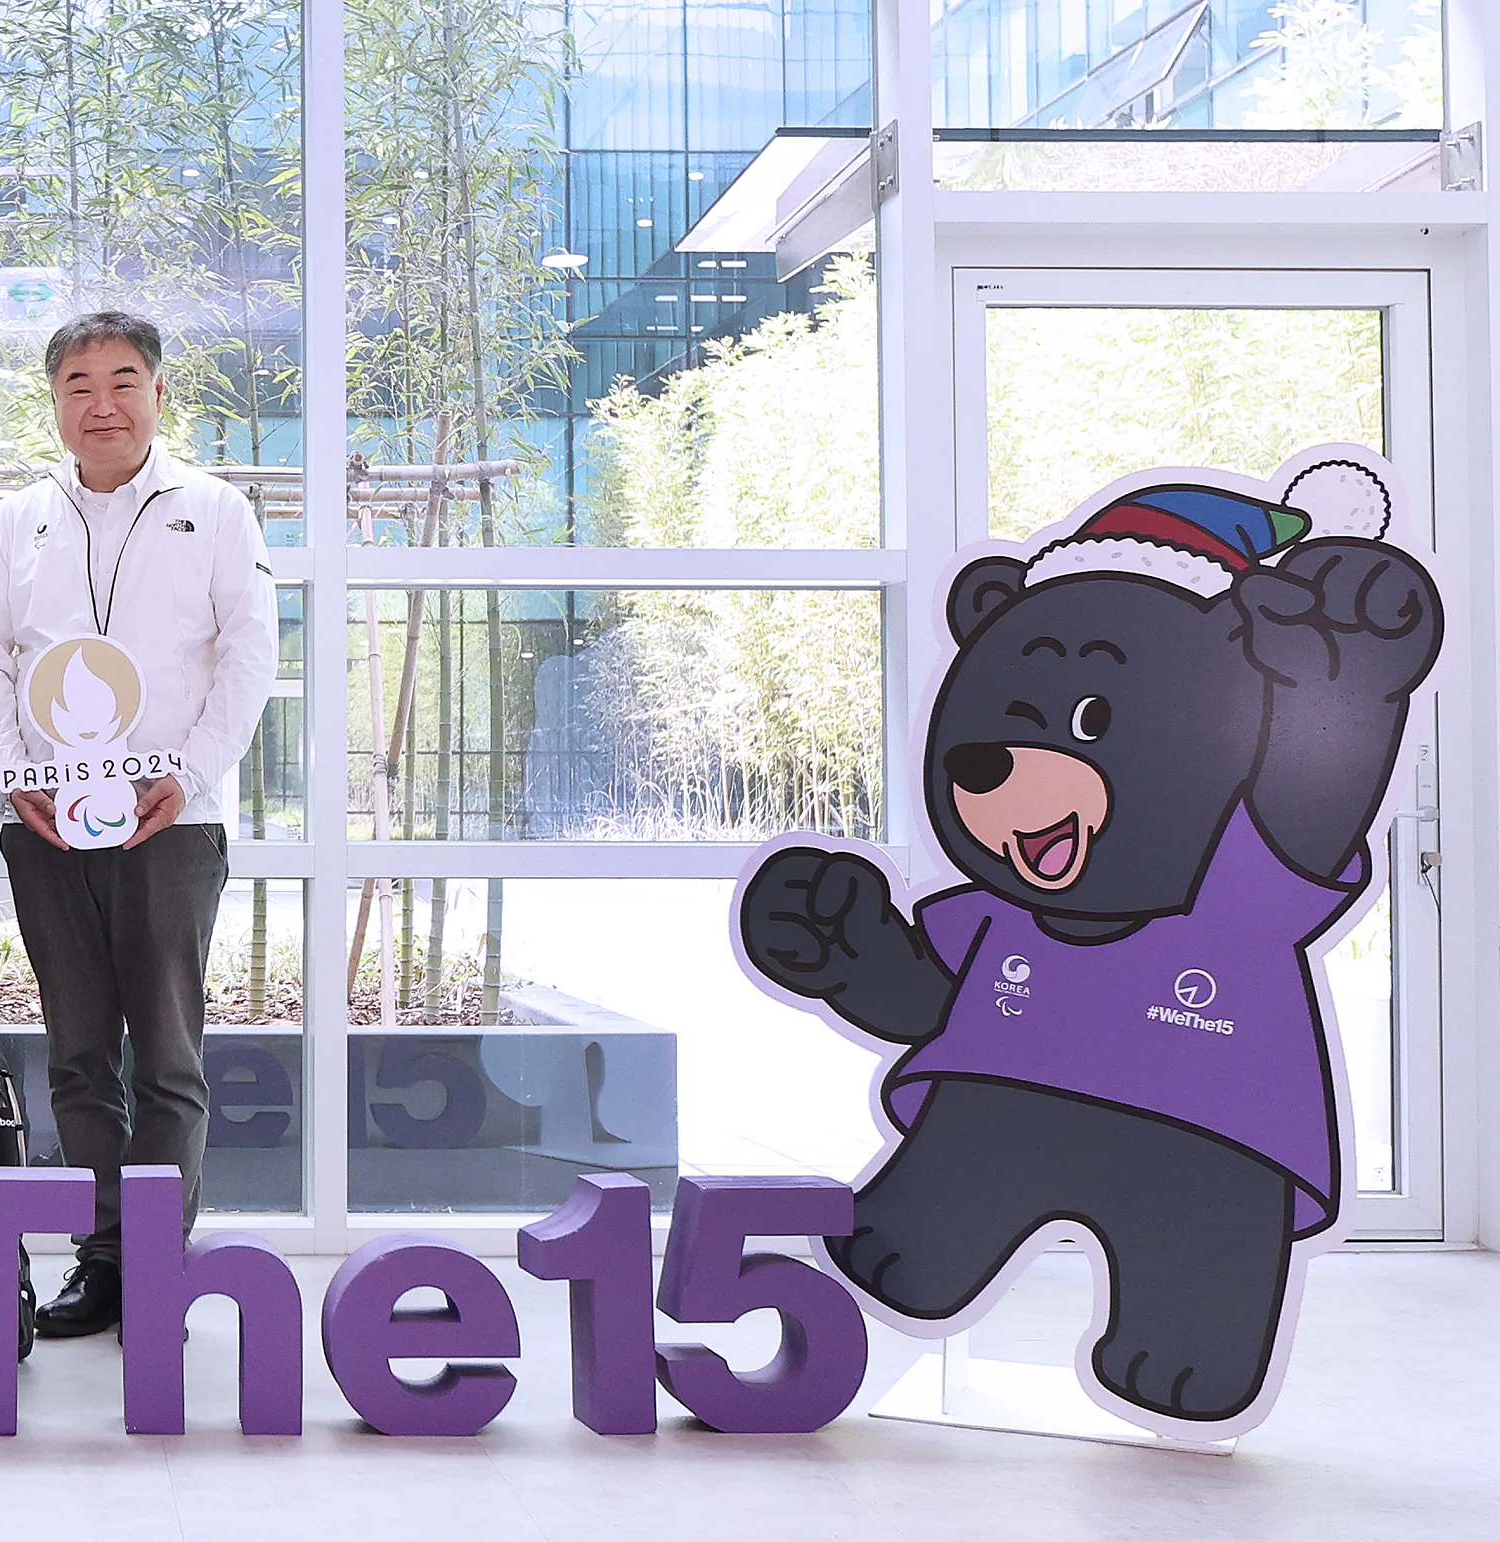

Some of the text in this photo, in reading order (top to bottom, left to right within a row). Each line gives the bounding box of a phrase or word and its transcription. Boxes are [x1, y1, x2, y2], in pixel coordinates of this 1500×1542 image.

[102, 752, 182, 779] 2024
[993, 980, 1031, 996] KOREA
[1146, 1005, 1235, 1035] #WeThe15
